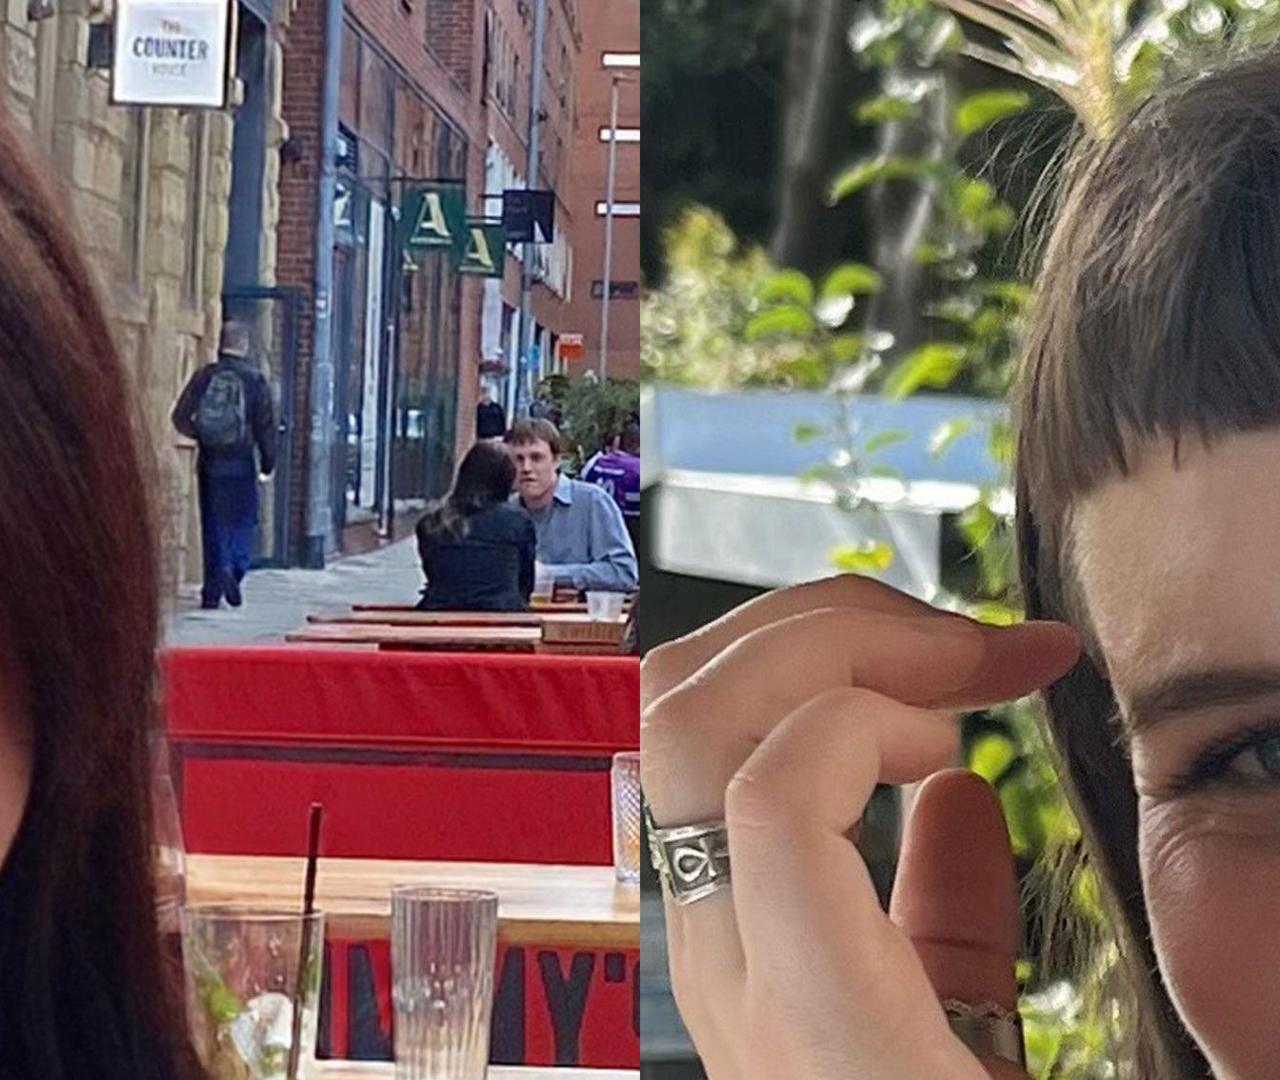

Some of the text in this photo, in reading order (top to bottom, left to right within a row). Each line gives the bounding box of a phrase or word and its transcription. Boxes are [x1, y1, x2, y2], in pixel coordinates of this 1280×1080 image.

[133, 37, 209, 60] COUNTER
[410, 192, 452, 237] A
[461, 228, 495, 267] A
